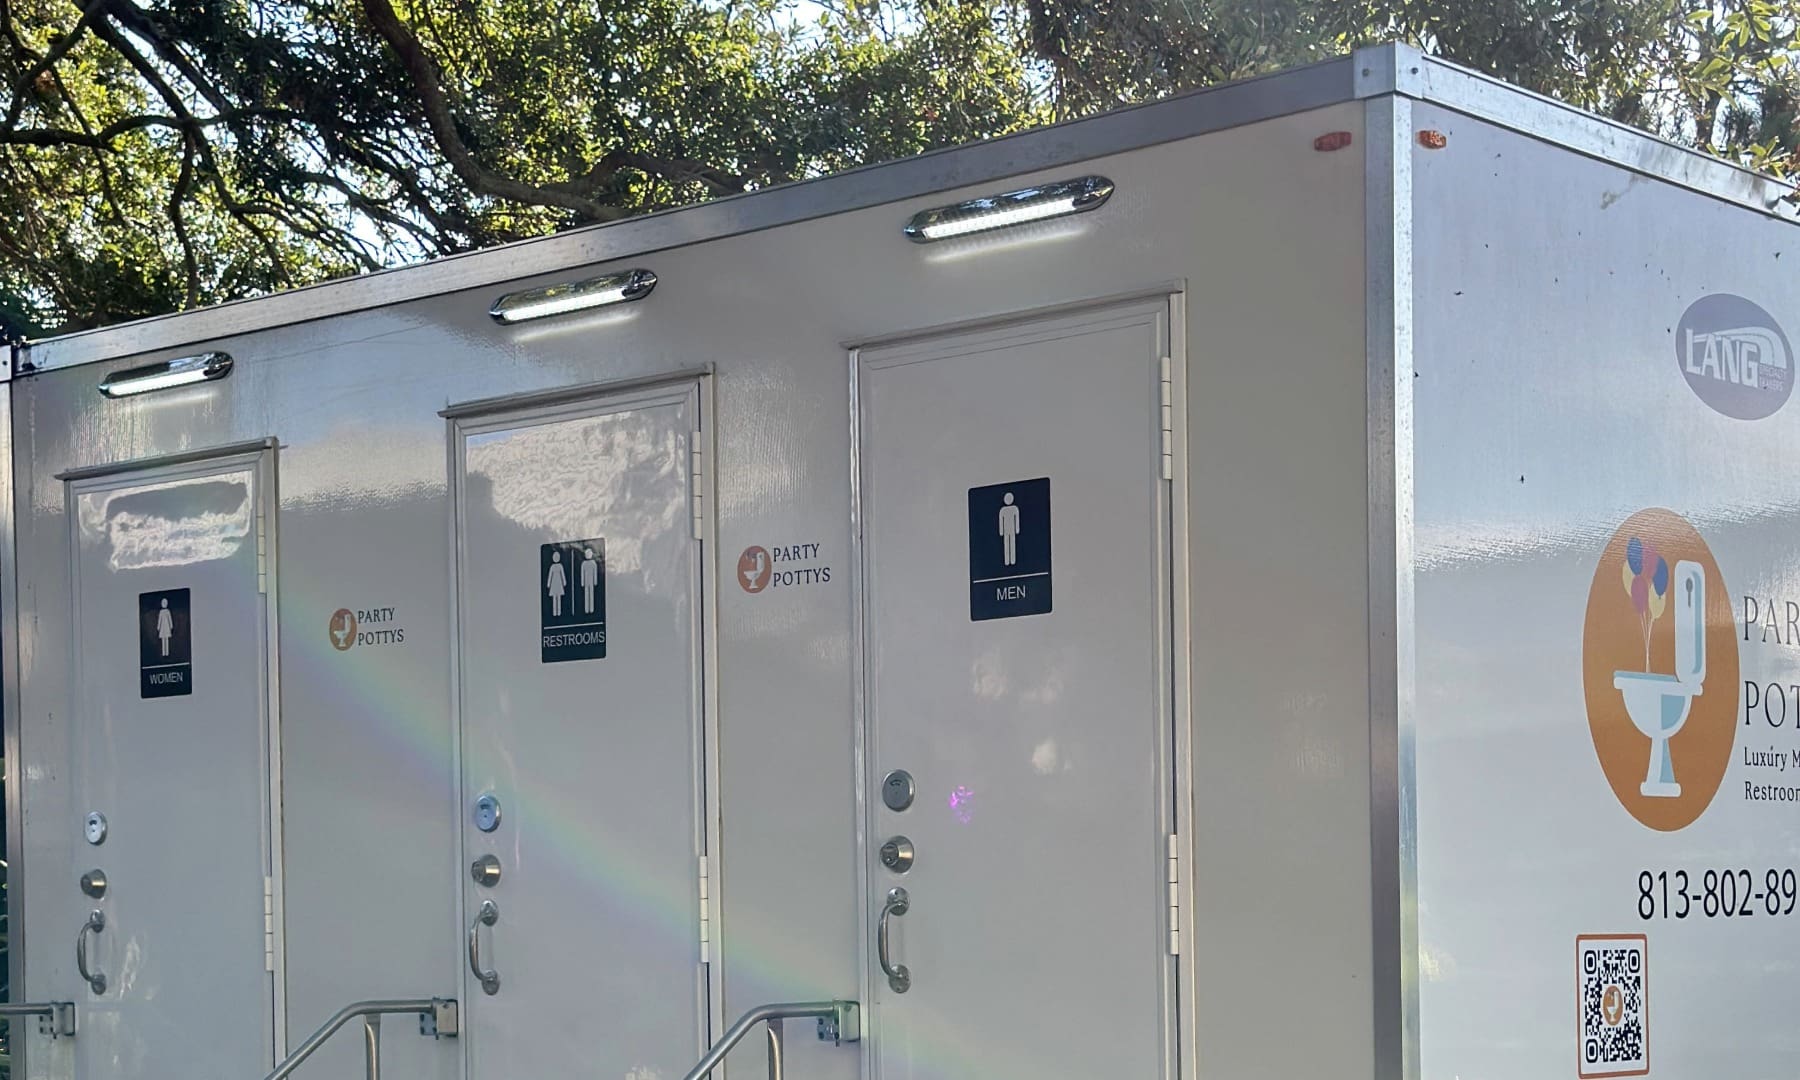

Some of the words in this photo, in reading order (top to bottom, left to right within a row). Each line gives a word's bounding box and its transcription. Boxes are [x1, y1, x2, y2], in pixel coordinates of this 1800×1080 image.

[1685, 328, 1759, 388] LANG
[773, 543, 821, 562] PARTY
[773, 567, 831, 587] POTTYS
[996, 585, 1026, 601] MEN
[357, 607, 395, 624] PARTY
[357, 629, 405, 646] POTTYS
[542, 631, 606, 648] RESTROOMS
[149, 671, 184, 685] WOMEN
[1637, 868, 1797, 920] 813-802-89
